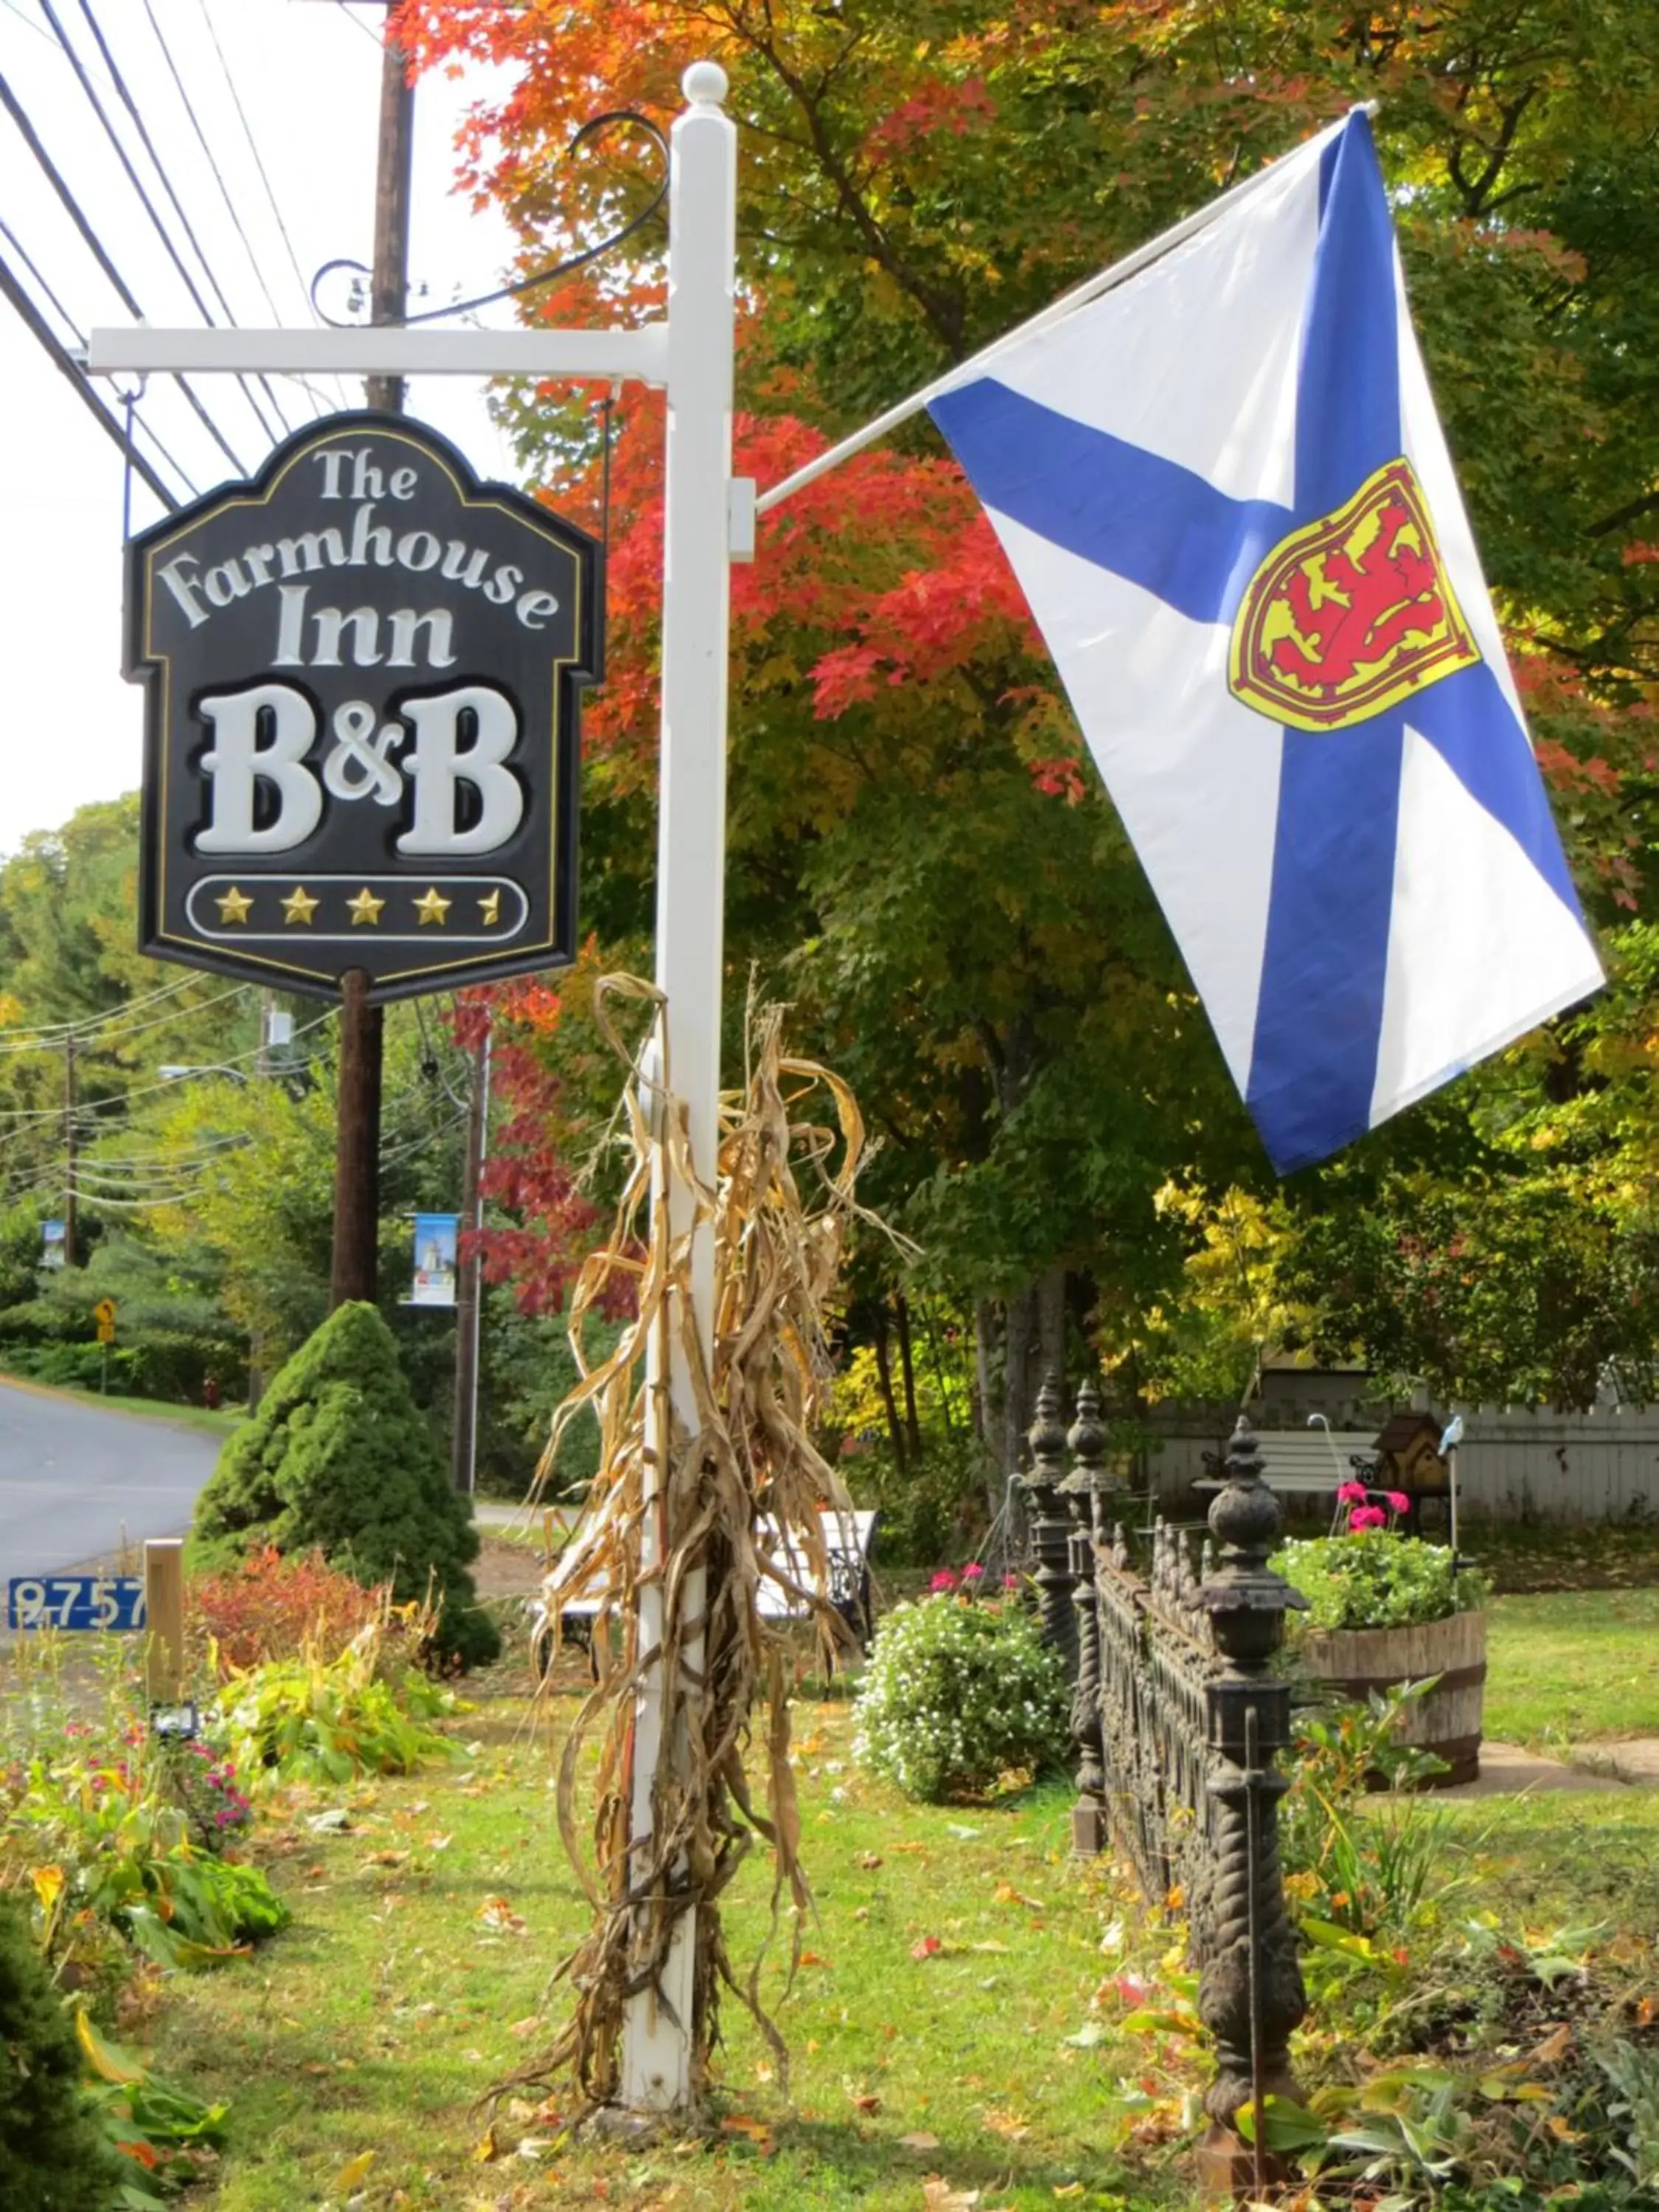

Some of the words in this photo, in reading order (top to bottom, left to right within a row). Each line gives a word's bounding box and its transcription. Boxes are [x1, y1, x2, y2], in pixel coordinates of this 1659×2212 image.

[313, 448, 419, 500] The
[156, 503, 560, 630] Farmhouse
[272, 585, 459, 667] Inn
[195, 684, 524, 855] B&B
[15, 1581, 146, 1627] 9757
